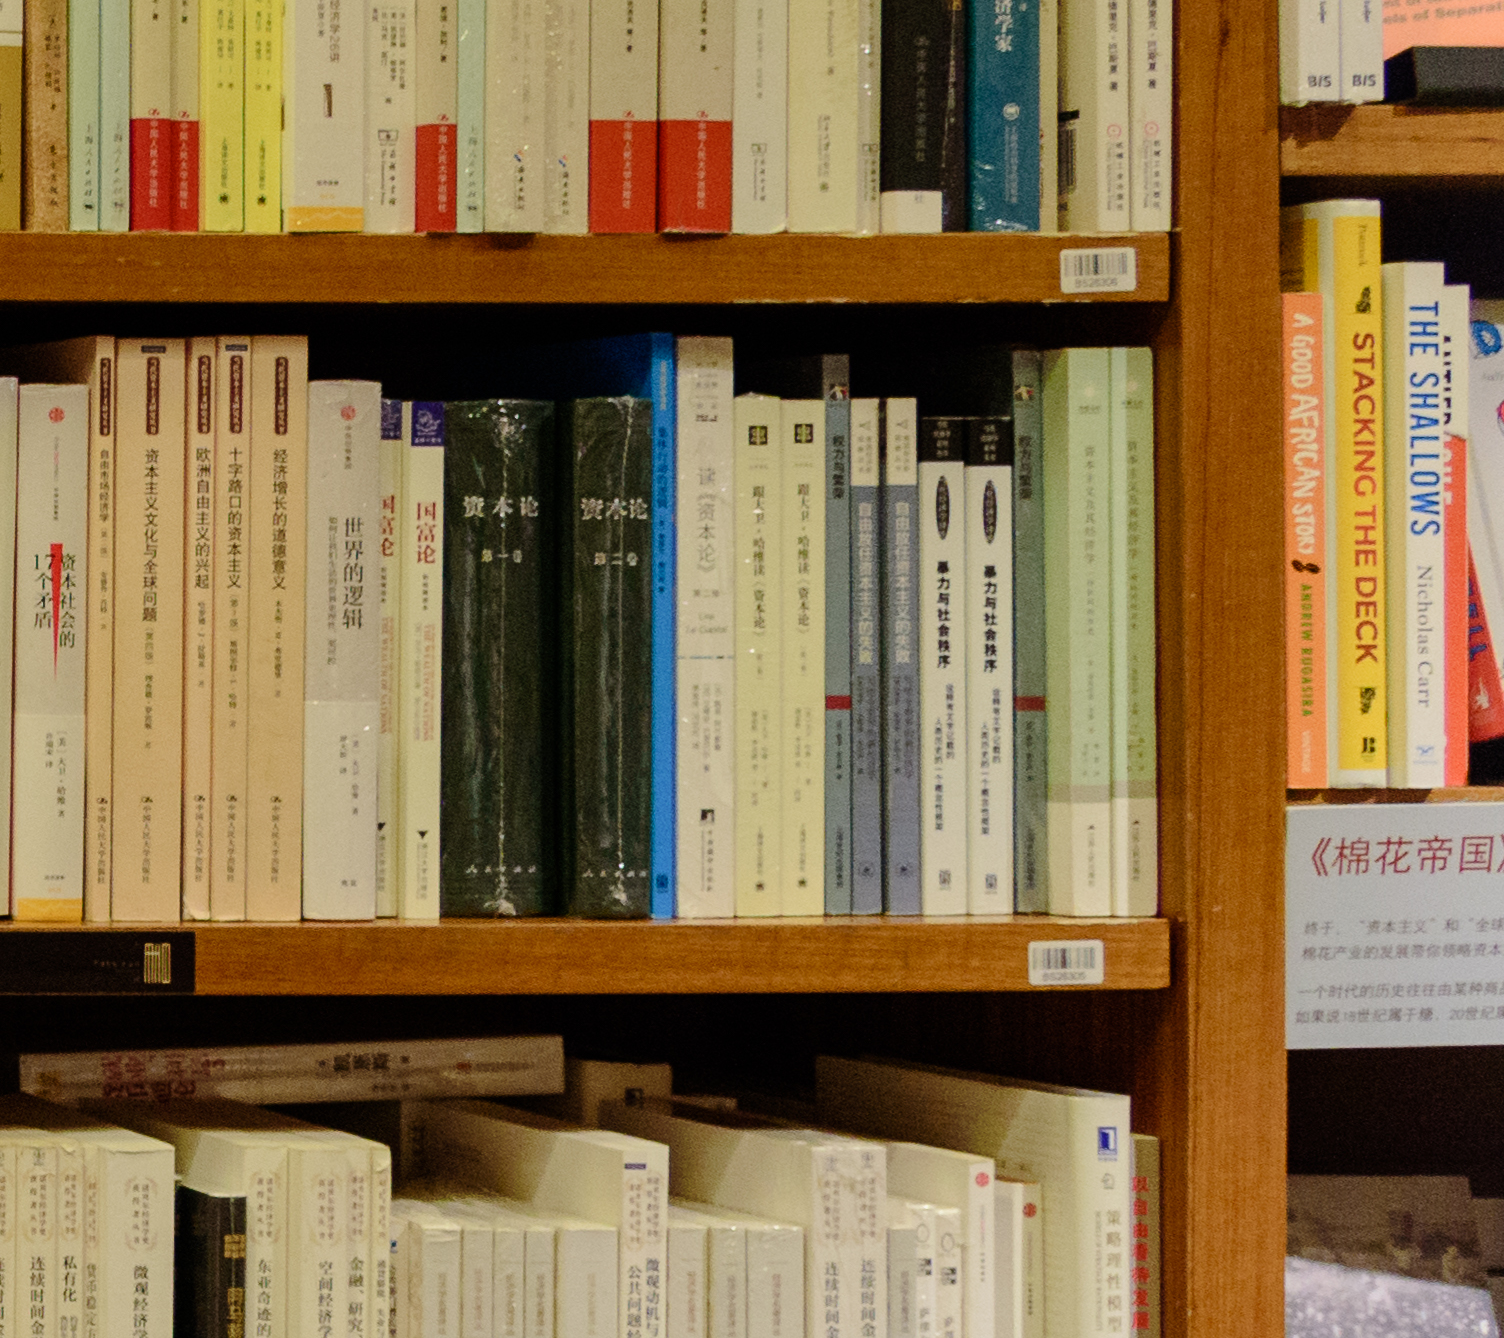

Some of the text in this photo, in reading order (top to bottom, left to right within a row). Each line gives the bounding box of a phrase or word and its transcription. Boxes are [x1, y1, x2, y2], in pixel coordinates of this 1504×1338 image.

[1353, 333, 1378, 663] STACKING THE DECK
[1409, 301, 1441, 536] THE SHALLOWS
[1416, 566, 1433, 708] Nicholas Carr
